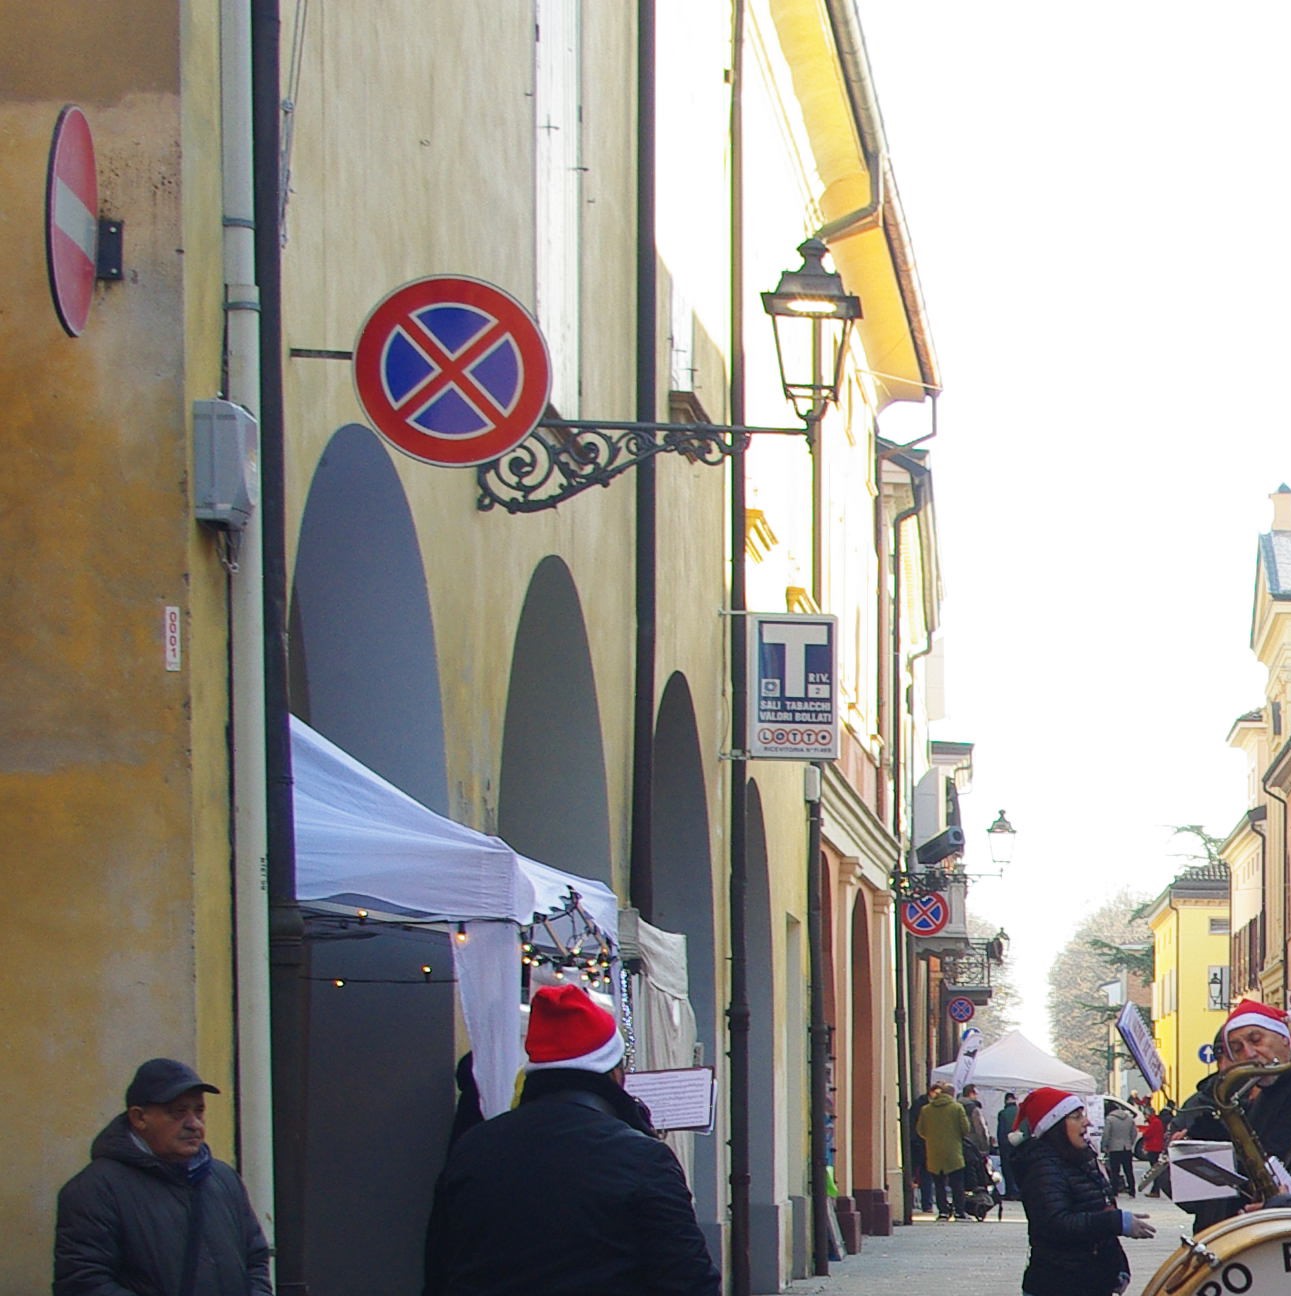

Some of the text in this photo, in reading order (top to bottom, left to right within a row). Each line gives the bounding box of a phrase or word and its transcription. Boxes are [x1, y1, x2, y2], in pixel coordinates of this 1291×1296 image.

[762, 624, 828, 697] T
[808, 673, 830, 683] RIV.
[760, 700, 832, 711] SALI TABACCHI
[760, 711, 832, 722] VALORI BOLLATI
